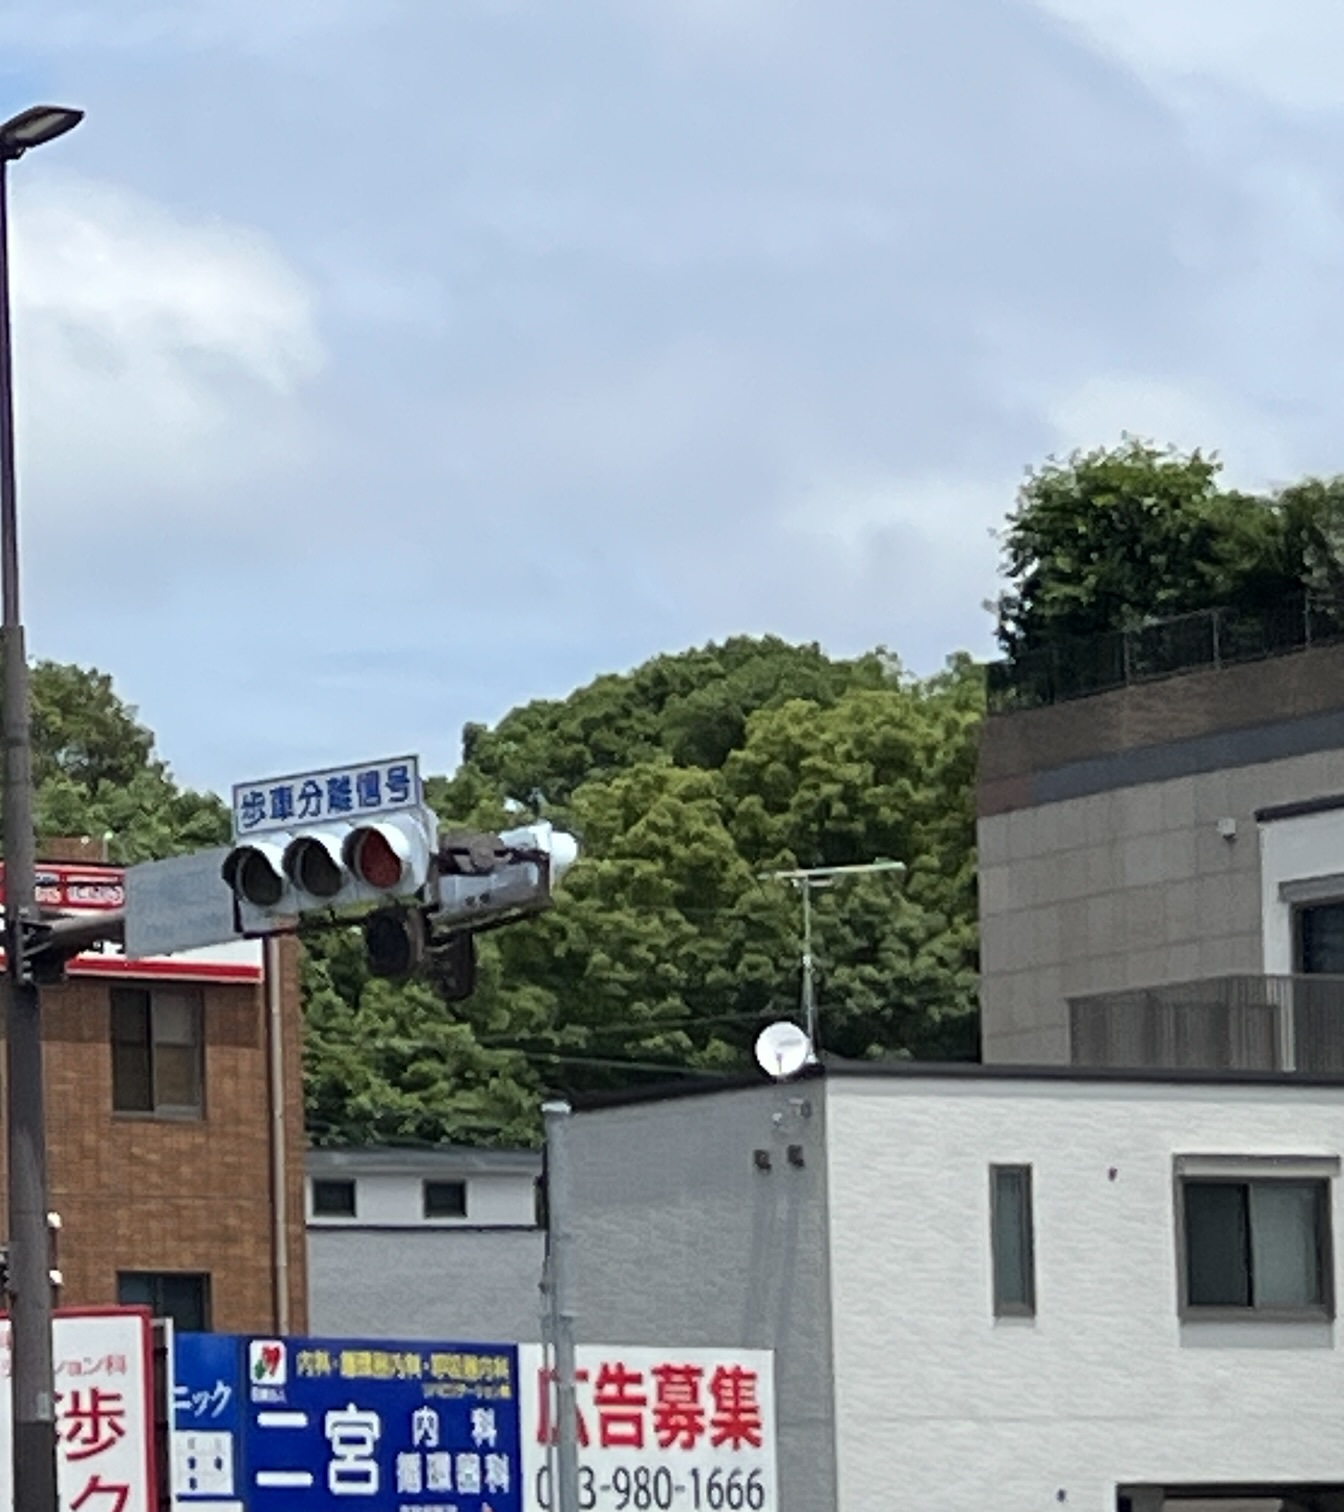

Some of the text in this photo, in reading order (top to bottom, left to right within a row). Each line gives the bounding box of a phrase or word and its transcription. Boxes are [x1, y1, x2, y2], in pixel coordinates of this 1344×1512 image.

[241, 765, 410, 828] 歩車分離信号
[256, 1402, 382, 1496] 二宮
[537, 1466, 765, 1510] 03-980-1666
